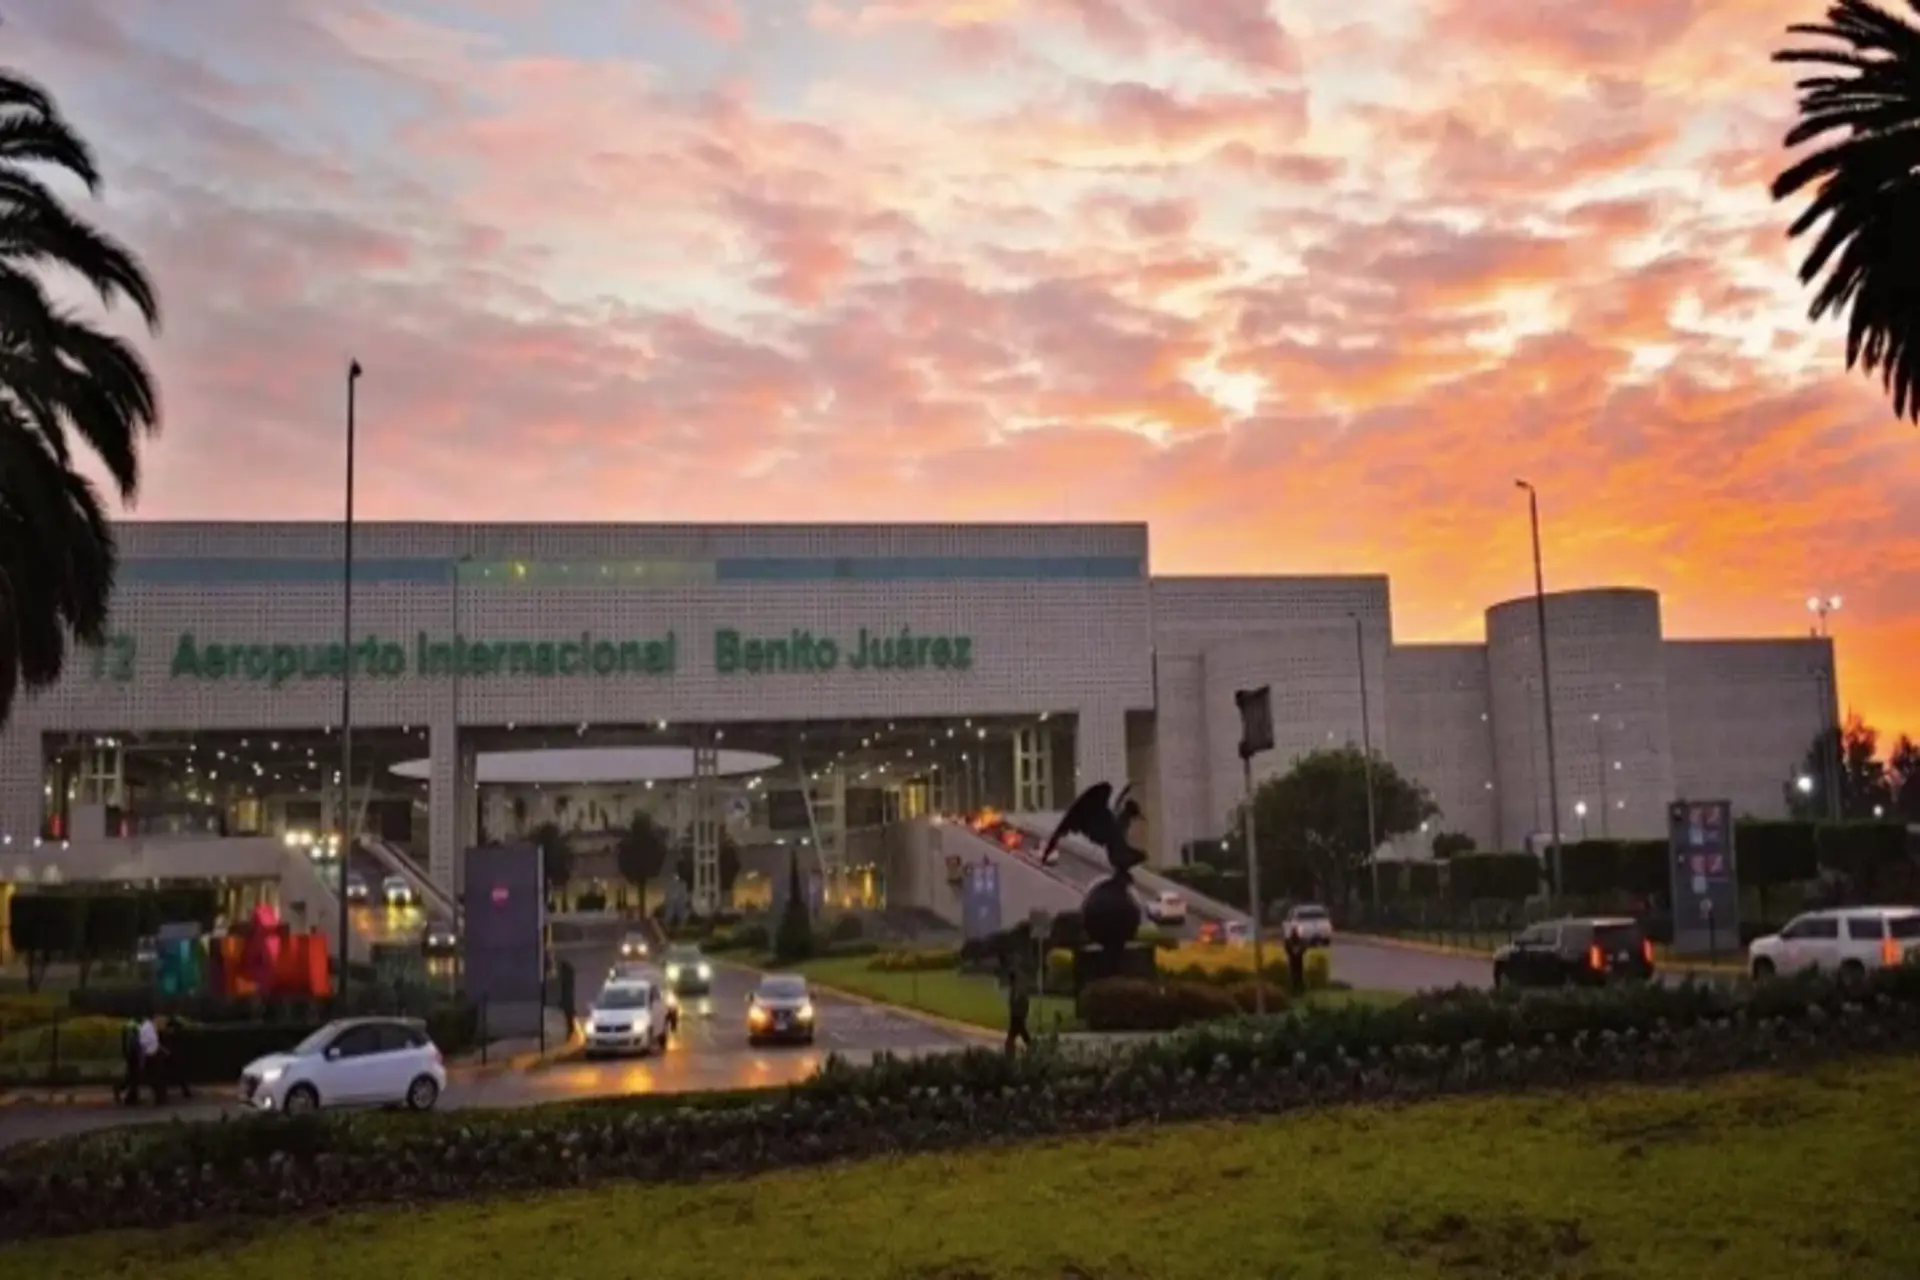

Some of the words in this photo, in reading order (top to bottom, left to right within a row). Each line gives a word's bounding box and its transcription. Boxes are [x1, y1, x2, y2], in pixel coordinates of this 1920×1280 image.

[170, 632, 407, 690] Aeropuerto
[418, 630, 677, 676] Internacional
[714, 628, 839, 674] Benito
[846, 622, 973, 672] Juárez
